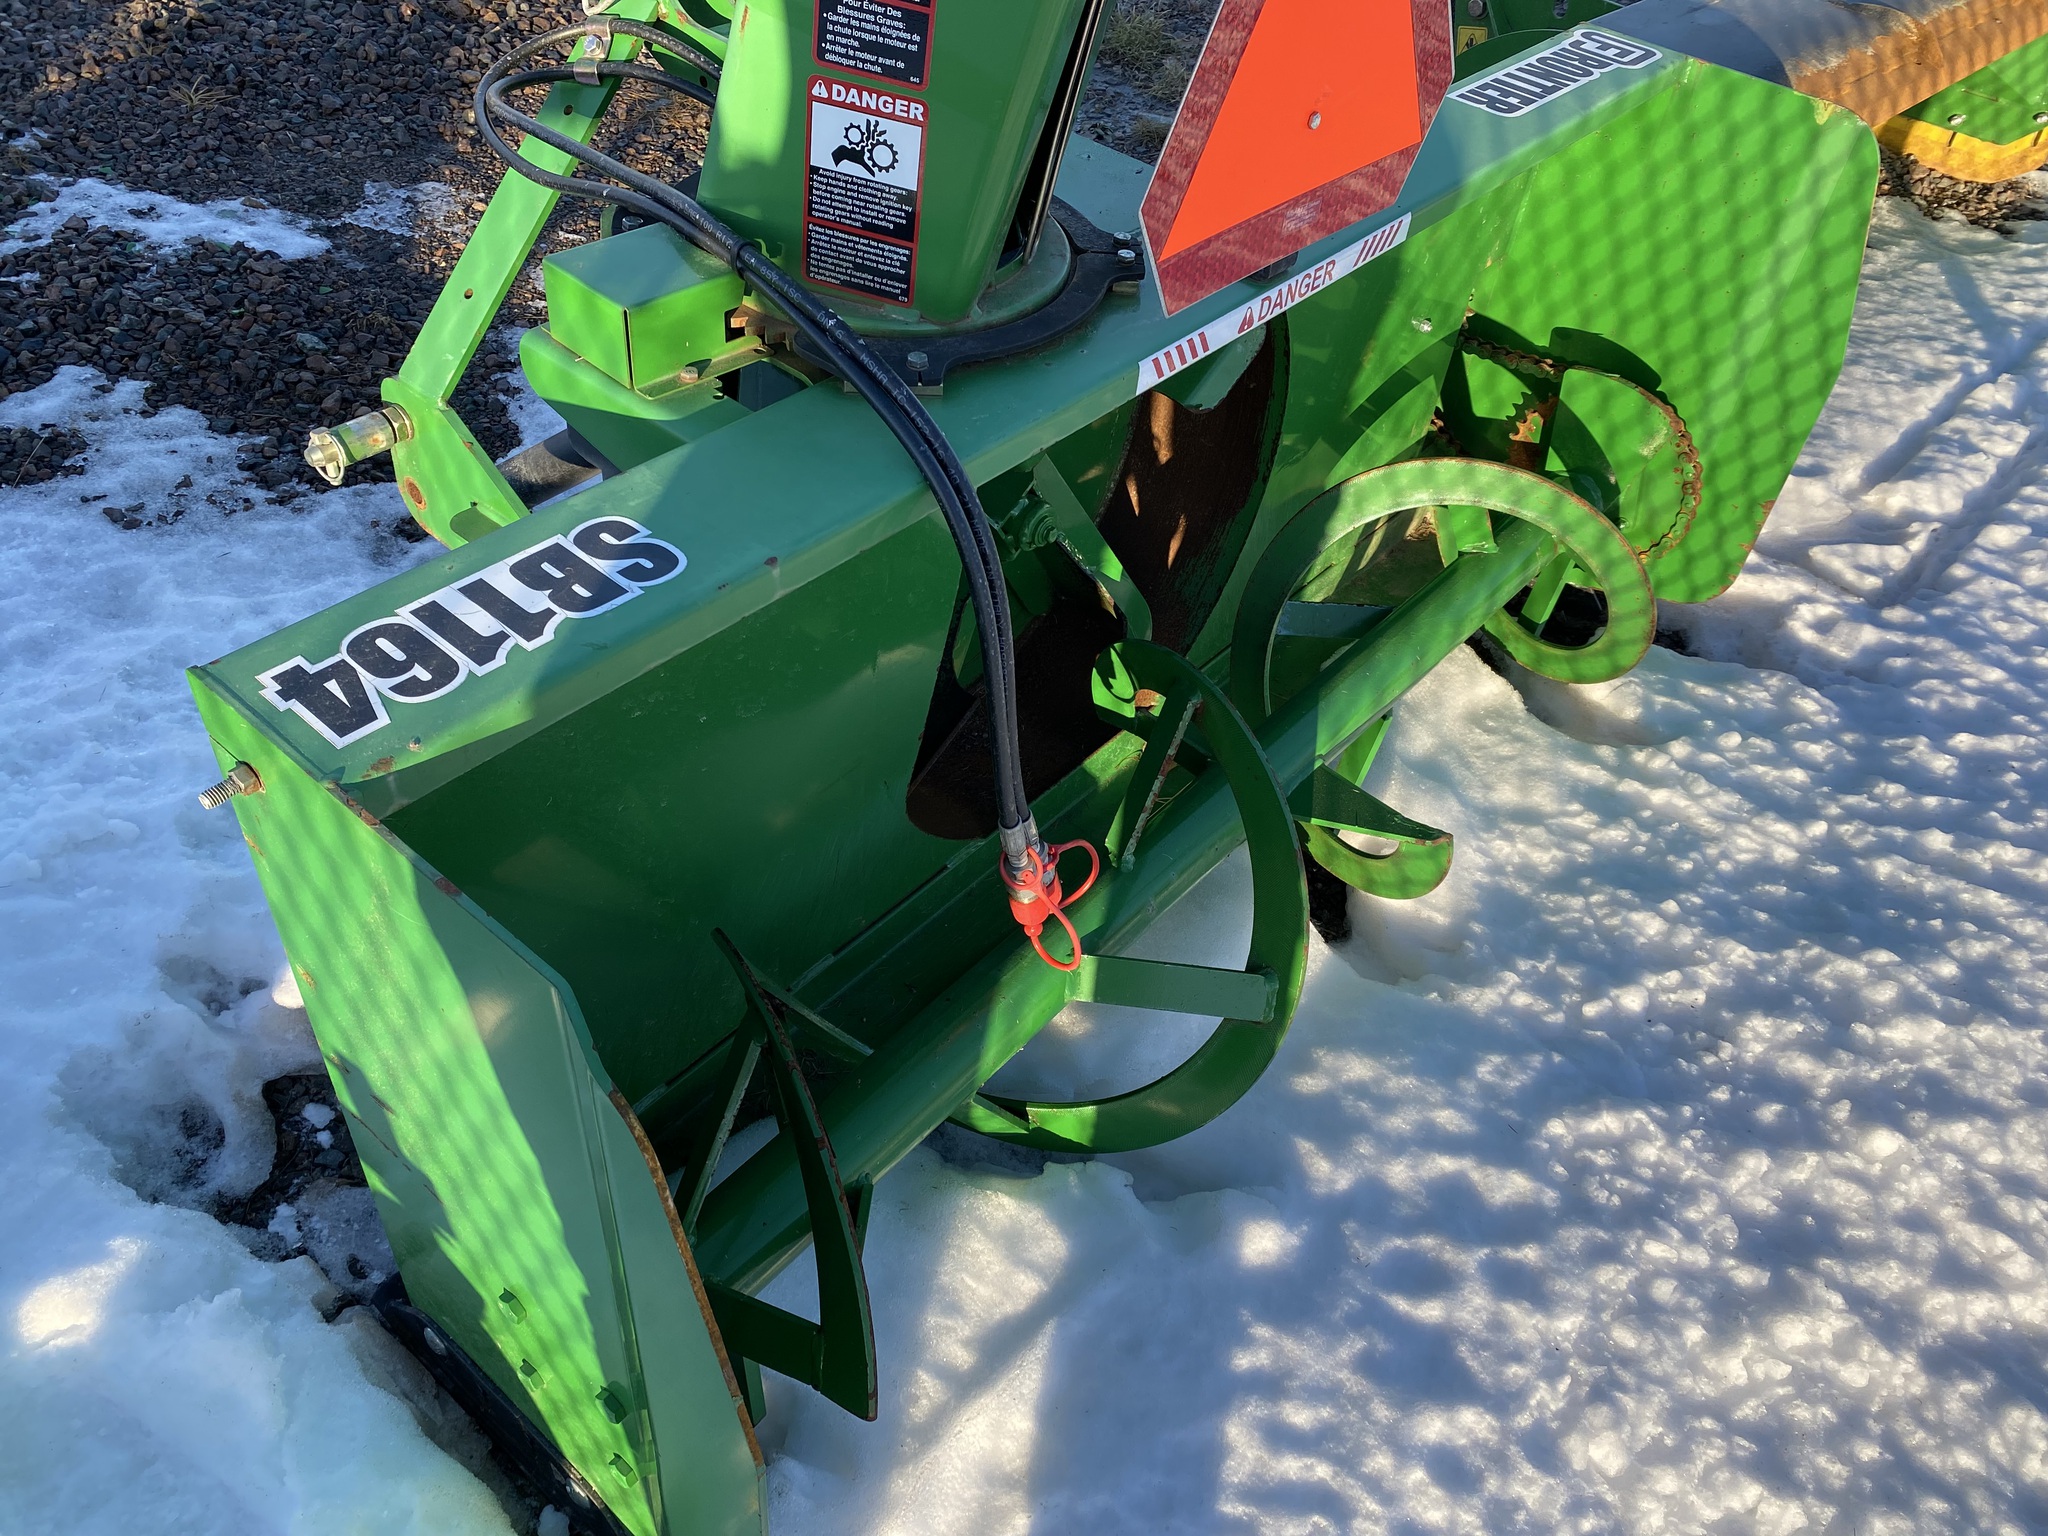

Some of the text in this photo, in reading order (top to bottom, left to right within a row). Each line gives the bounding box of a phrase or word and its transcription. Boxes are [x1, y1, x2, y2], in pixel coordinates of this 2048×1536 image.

[838, 5, 906, 29] Blessures Graves:
[863, 0, 885, 13] Éviter
[887, 7, 901, 17] Des
[827, 22, 833, 30] la
[834, 25, 852, 35] chute
[853, 29, 876, 41] lorsque
[878, 35, 883, 43] le
[885, 38, 907, 48] moteur
[828, 12, 920, 42] Garder les mains éloignées de
[826, 43, 847, 53] Arrêter
[848, 48, 854, 56] le
[855, 51, 877, 61] moteur
[878, 57, 895, 66] avant
[836, 36, 860, 47] marche.
[825, 53, 882, 73] débloquer la chute.
[1456, 30, 1658, 115] FRONTIER
[832, 84, 924, 121] DANGER
[814, 175, 828, 183] Keep
[829, 178, 846, 187] hands
[859, 187, 881, 197] clothing
[882, 193, 898, 201] away.
[819, 169, 835, 177] Avoid
[836, 173, 852, 182] injury
[853, 177, 866, 185] from
[867, 182, 889, 192] rotating
[813, 182, 826, 190] Stop
[827, 186, 846, 194] engine
[859, 194, 879, 203] remove
[880, 199, 901, 208] ignition
[903, 204, 912, 212] key
[813, 189, 830, 198] before
[832, 195, 852, 204] coming
[867, 204, 888, 213] rotating
[889, 209, 906, 217] gears.
[812, 204, 833, 214] rotating
[851, 214, 871, 222] without
[873, 219, 893, 229] reading
[812, 211, 862, 227] operator's manual.
[832, 202, 852, 211] attempt
[861, 208, 877, 216] install
[886, 216, 906, 224] remove
[700, 217, 713, 233] 100
[860, 353, 889, 384] MSHA
[1258, 259, 1336, 322] DANGER
[266, 519, 681, 740] SB1164
